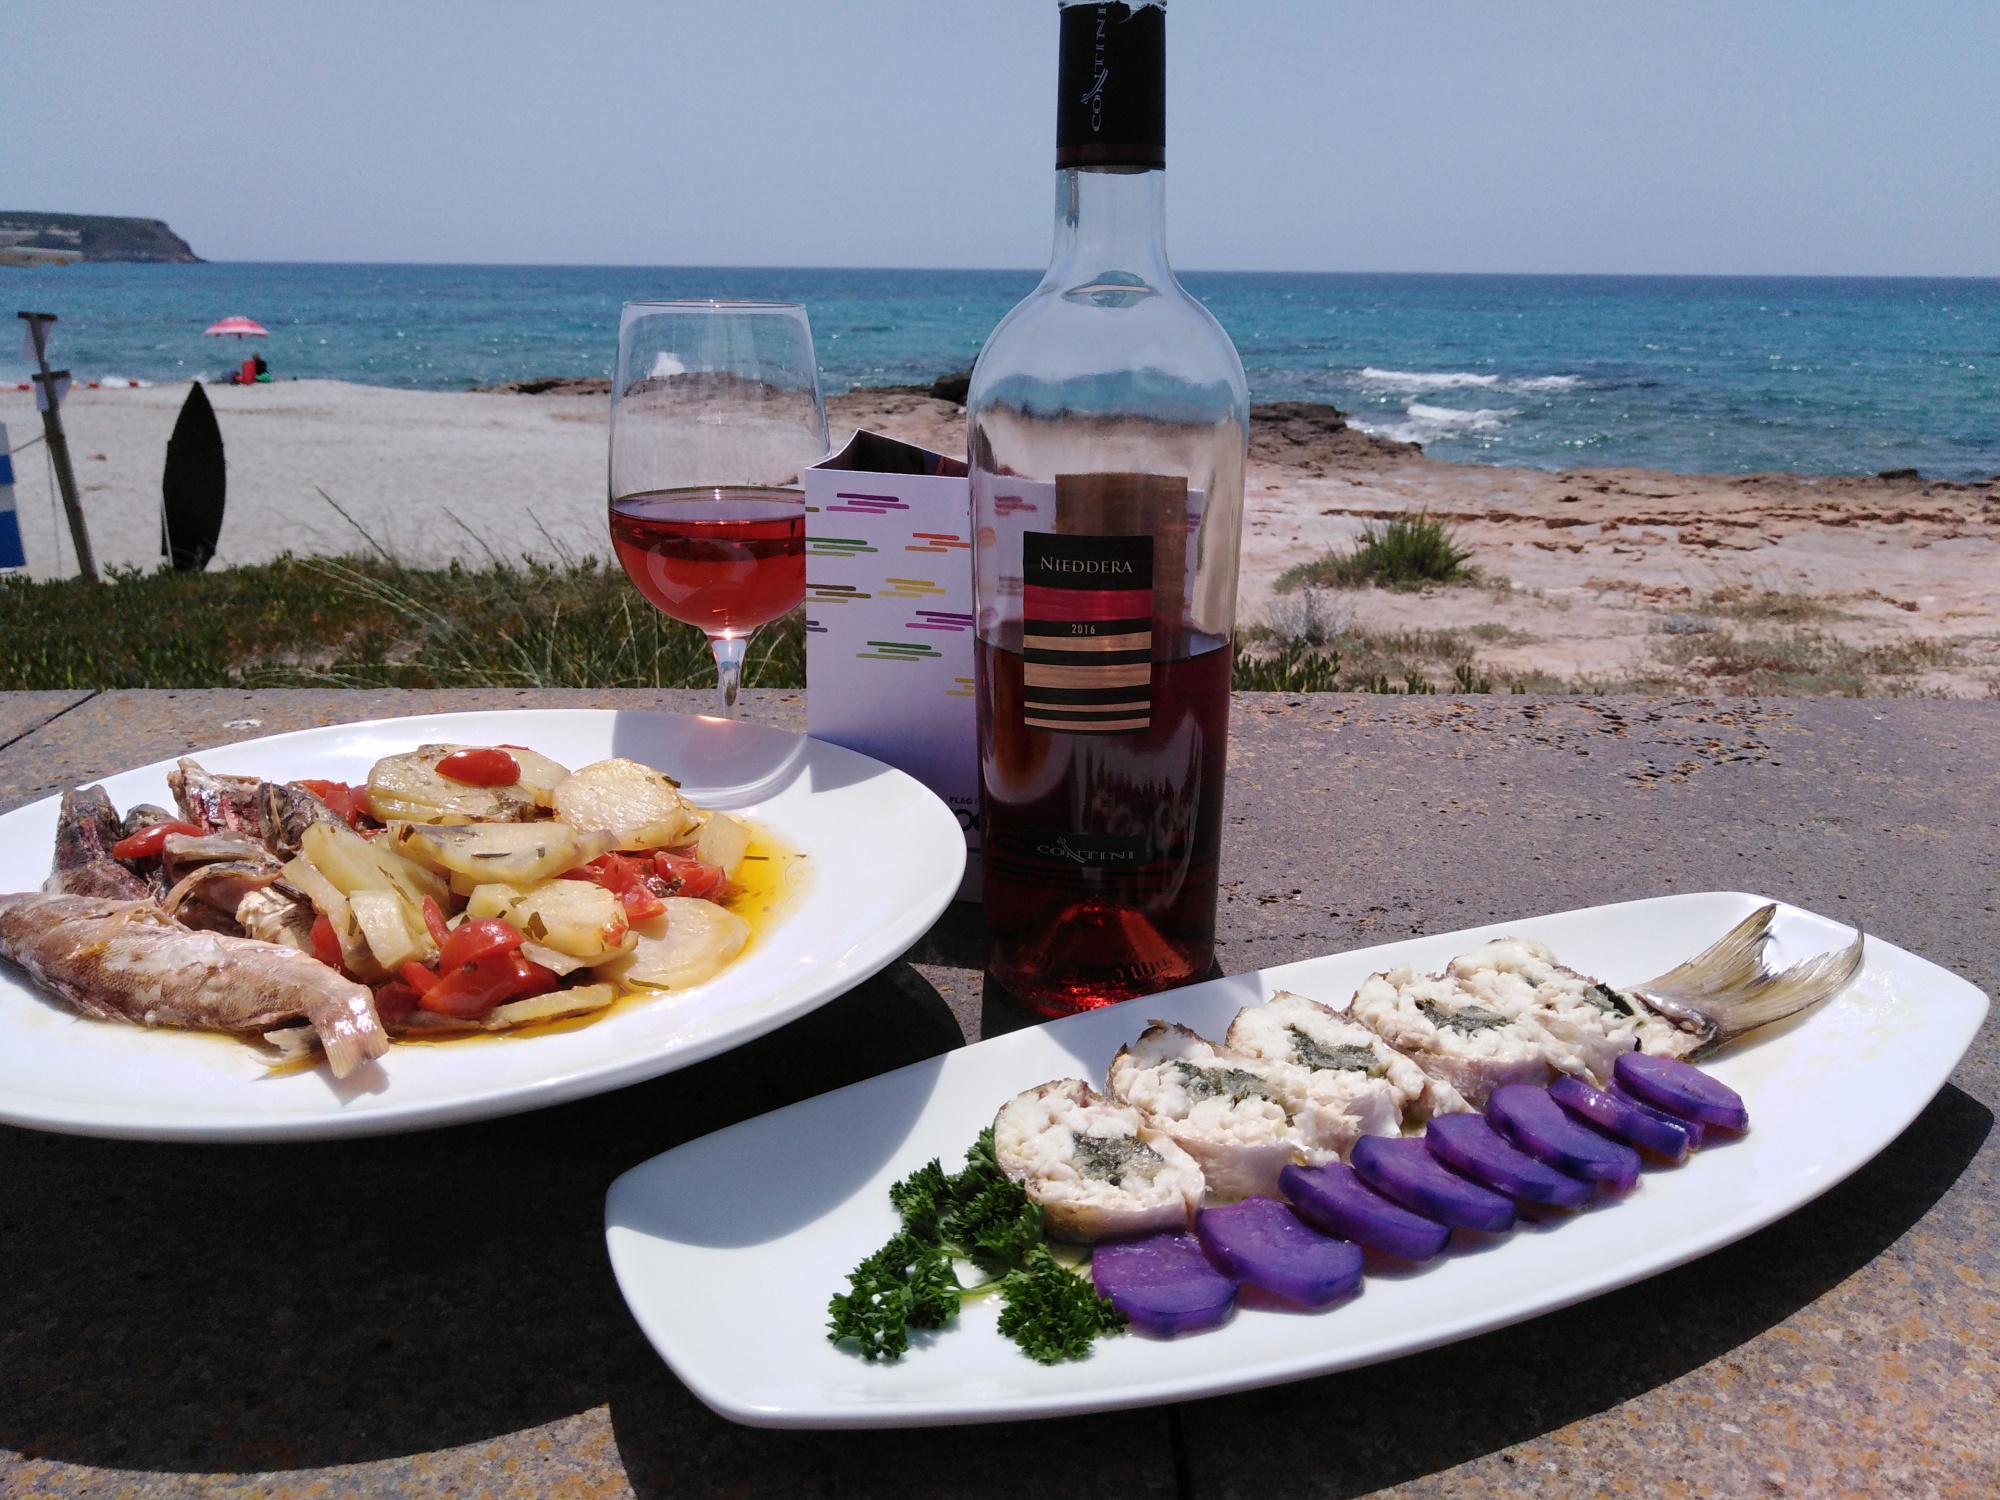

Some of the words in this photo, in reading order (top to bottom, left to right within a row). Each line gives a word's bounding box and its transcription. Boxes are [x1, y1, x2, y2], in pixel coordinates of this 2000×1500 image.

[1084, 7, 1108, 132] CONTINI
[1041, 556, 1133, 574] NIEDDERA
[1071, 623, 1096, 635] 2016
[949, 796, 973, 805] FLAG
[1036, 839, 1134, 863] CONTINI
